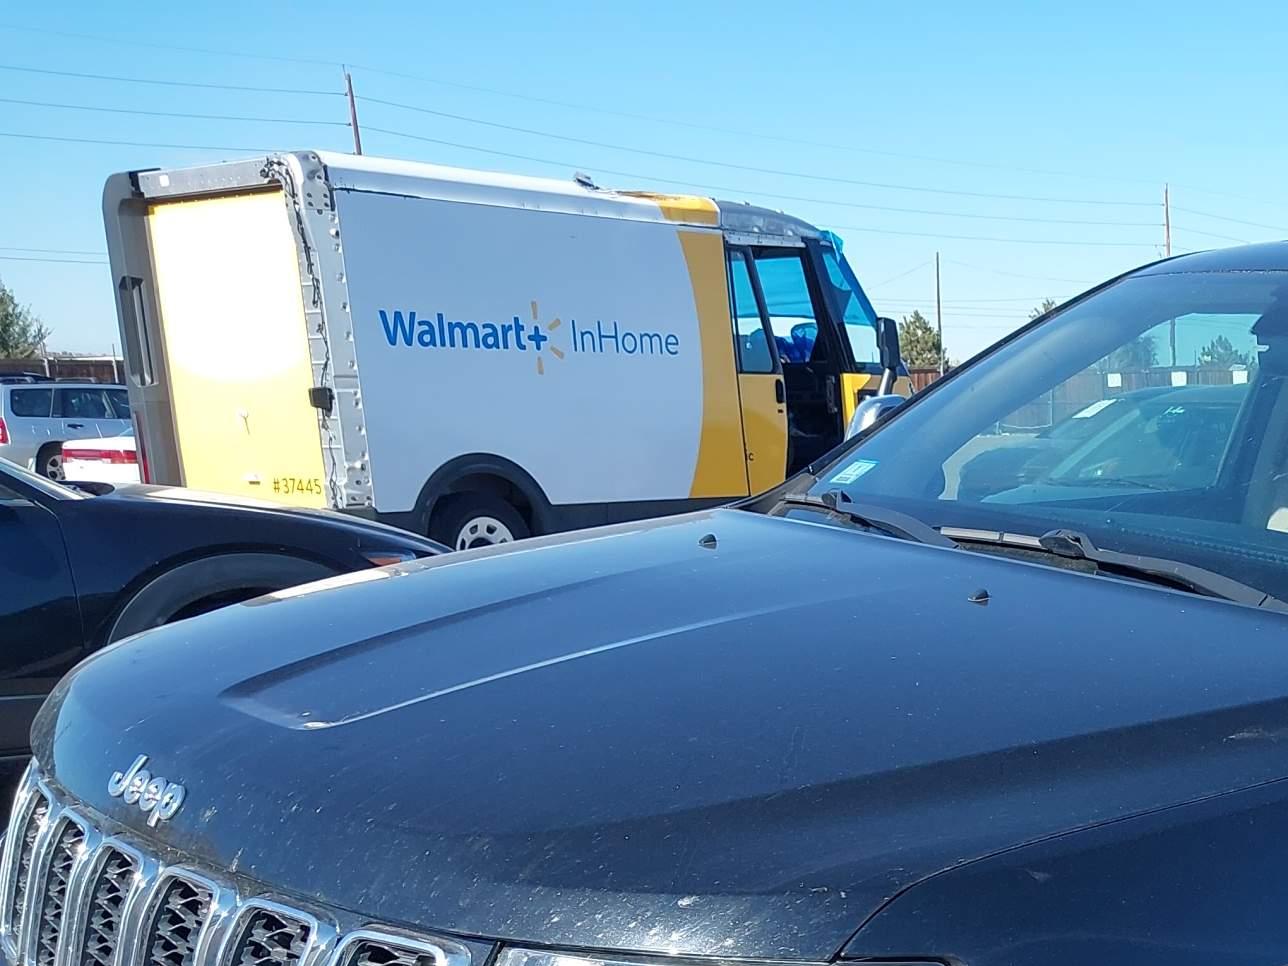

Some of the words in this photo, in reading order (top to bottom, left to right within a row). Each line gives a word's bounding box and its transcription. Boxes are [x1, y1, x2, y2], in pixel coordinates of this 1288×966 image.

[571, 319, 680, 355] InHome
[273, 477, 322, 495] #37445
[108, 754, 187, 827] Jeep
